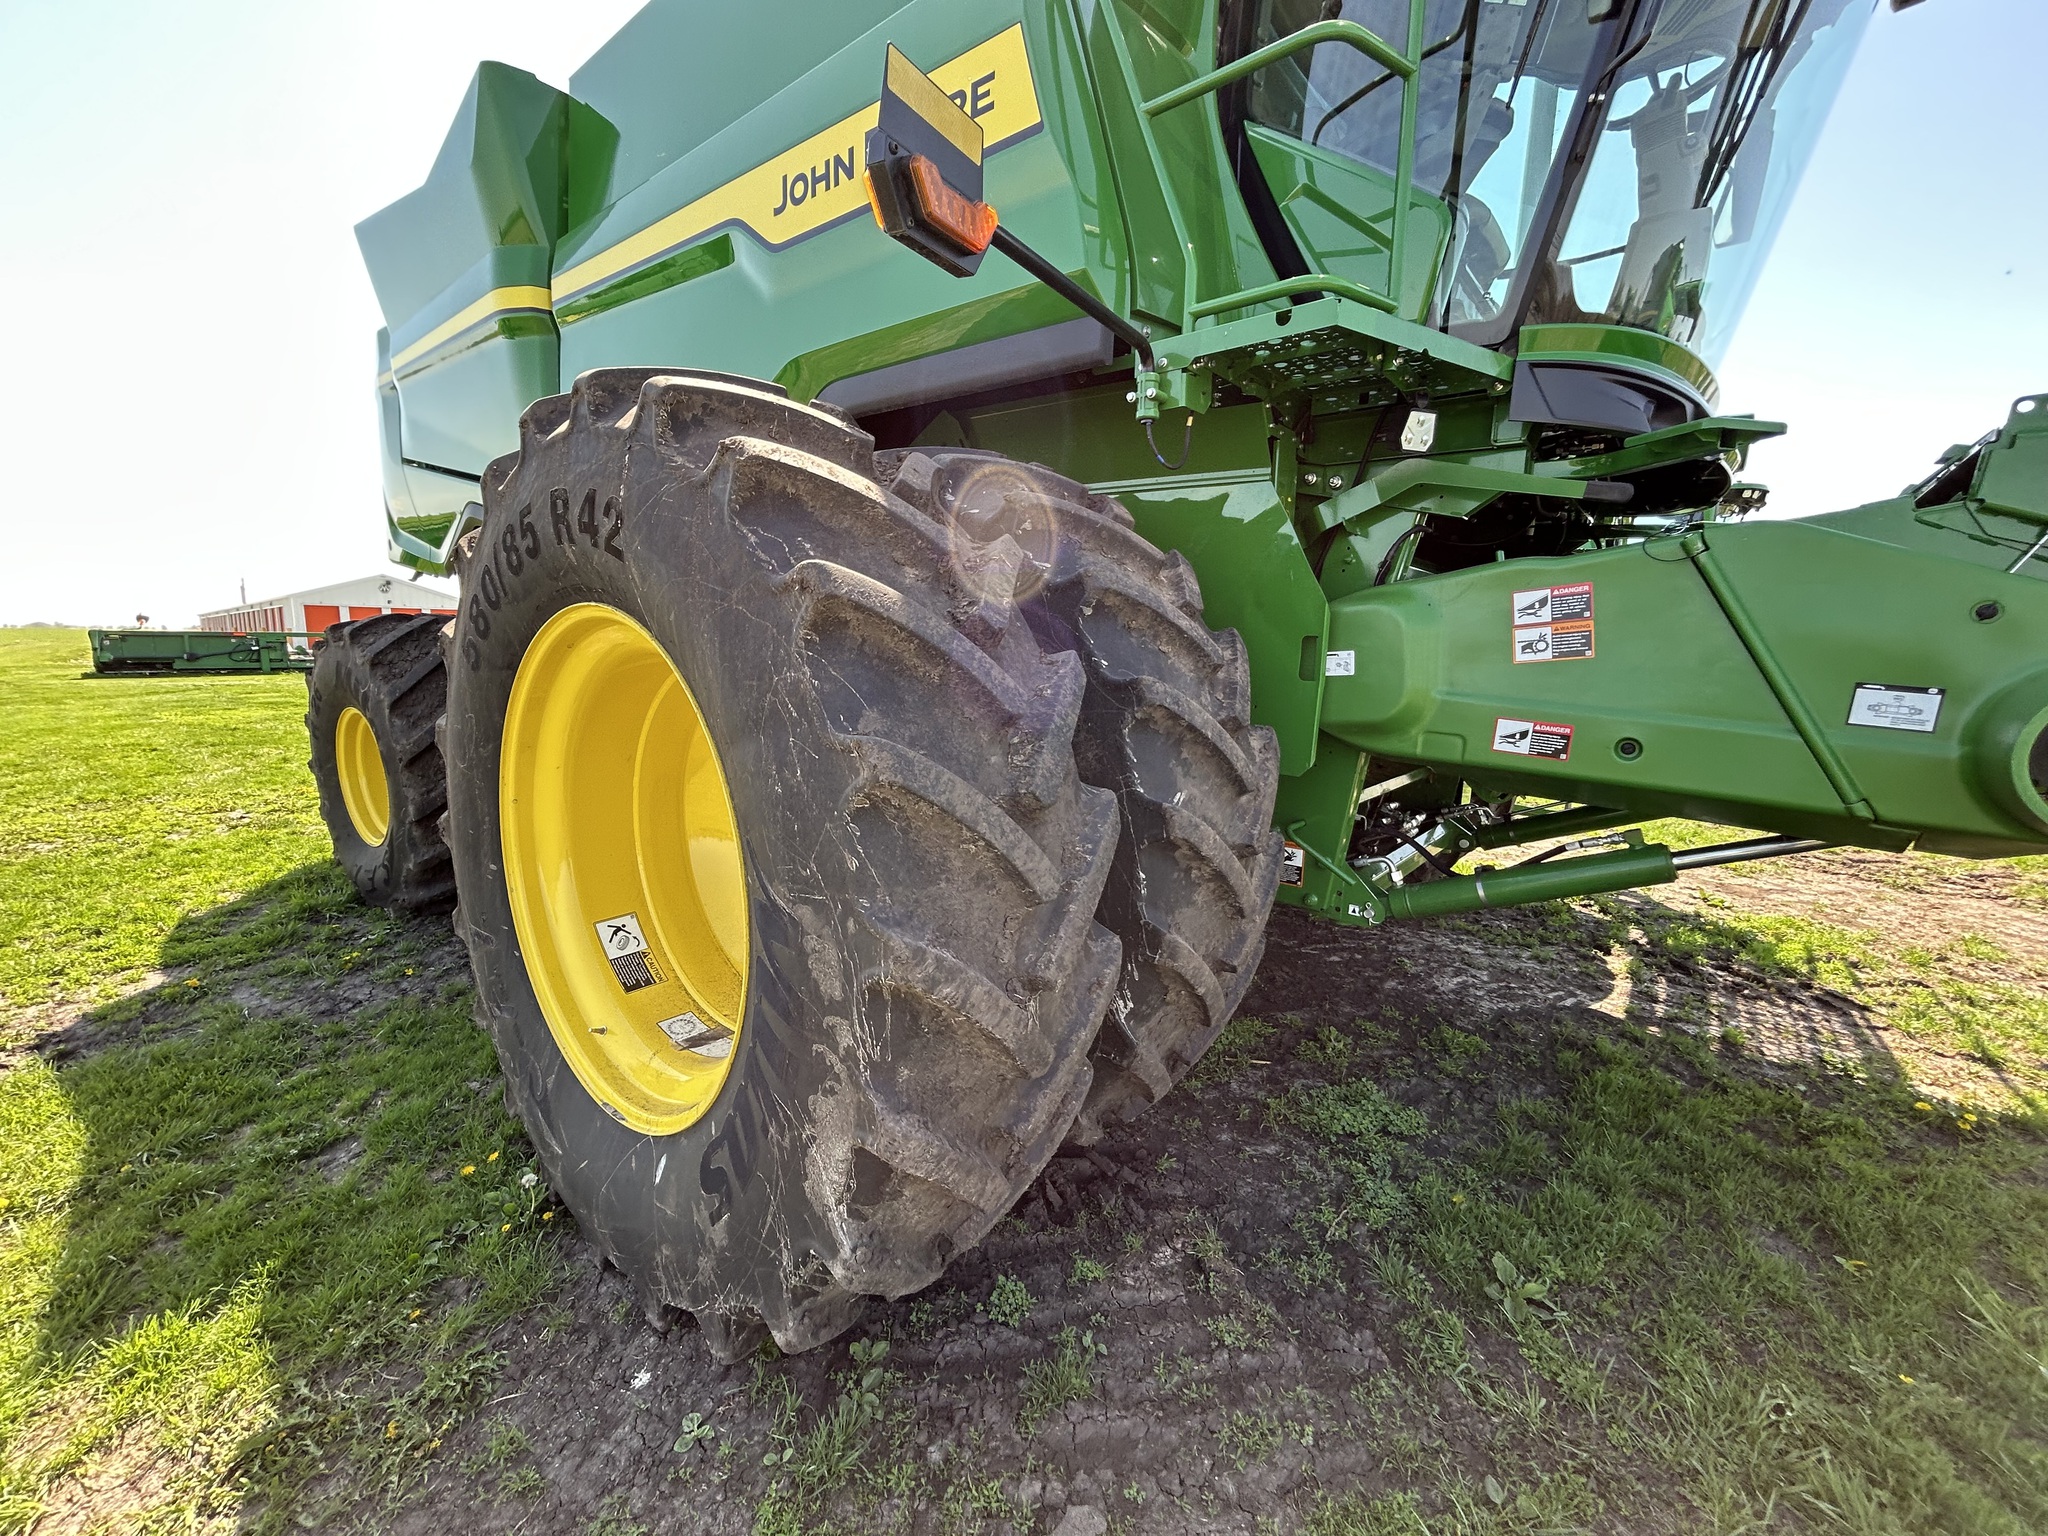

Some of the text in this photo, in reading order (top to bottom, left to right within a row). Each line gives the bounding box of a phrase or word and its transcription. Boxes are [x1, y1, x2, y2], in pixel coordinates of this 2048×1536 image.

[773, 146, 855, 217] JOHN
[550, 487, 625, 564] R42
[1559, 585, 1590, 594] DANGER
[1560, 623, 1591, 631] WARNING
[1541, 725, 1571, 734] DANGER
[646, 957, 665, 983] CAUTION
